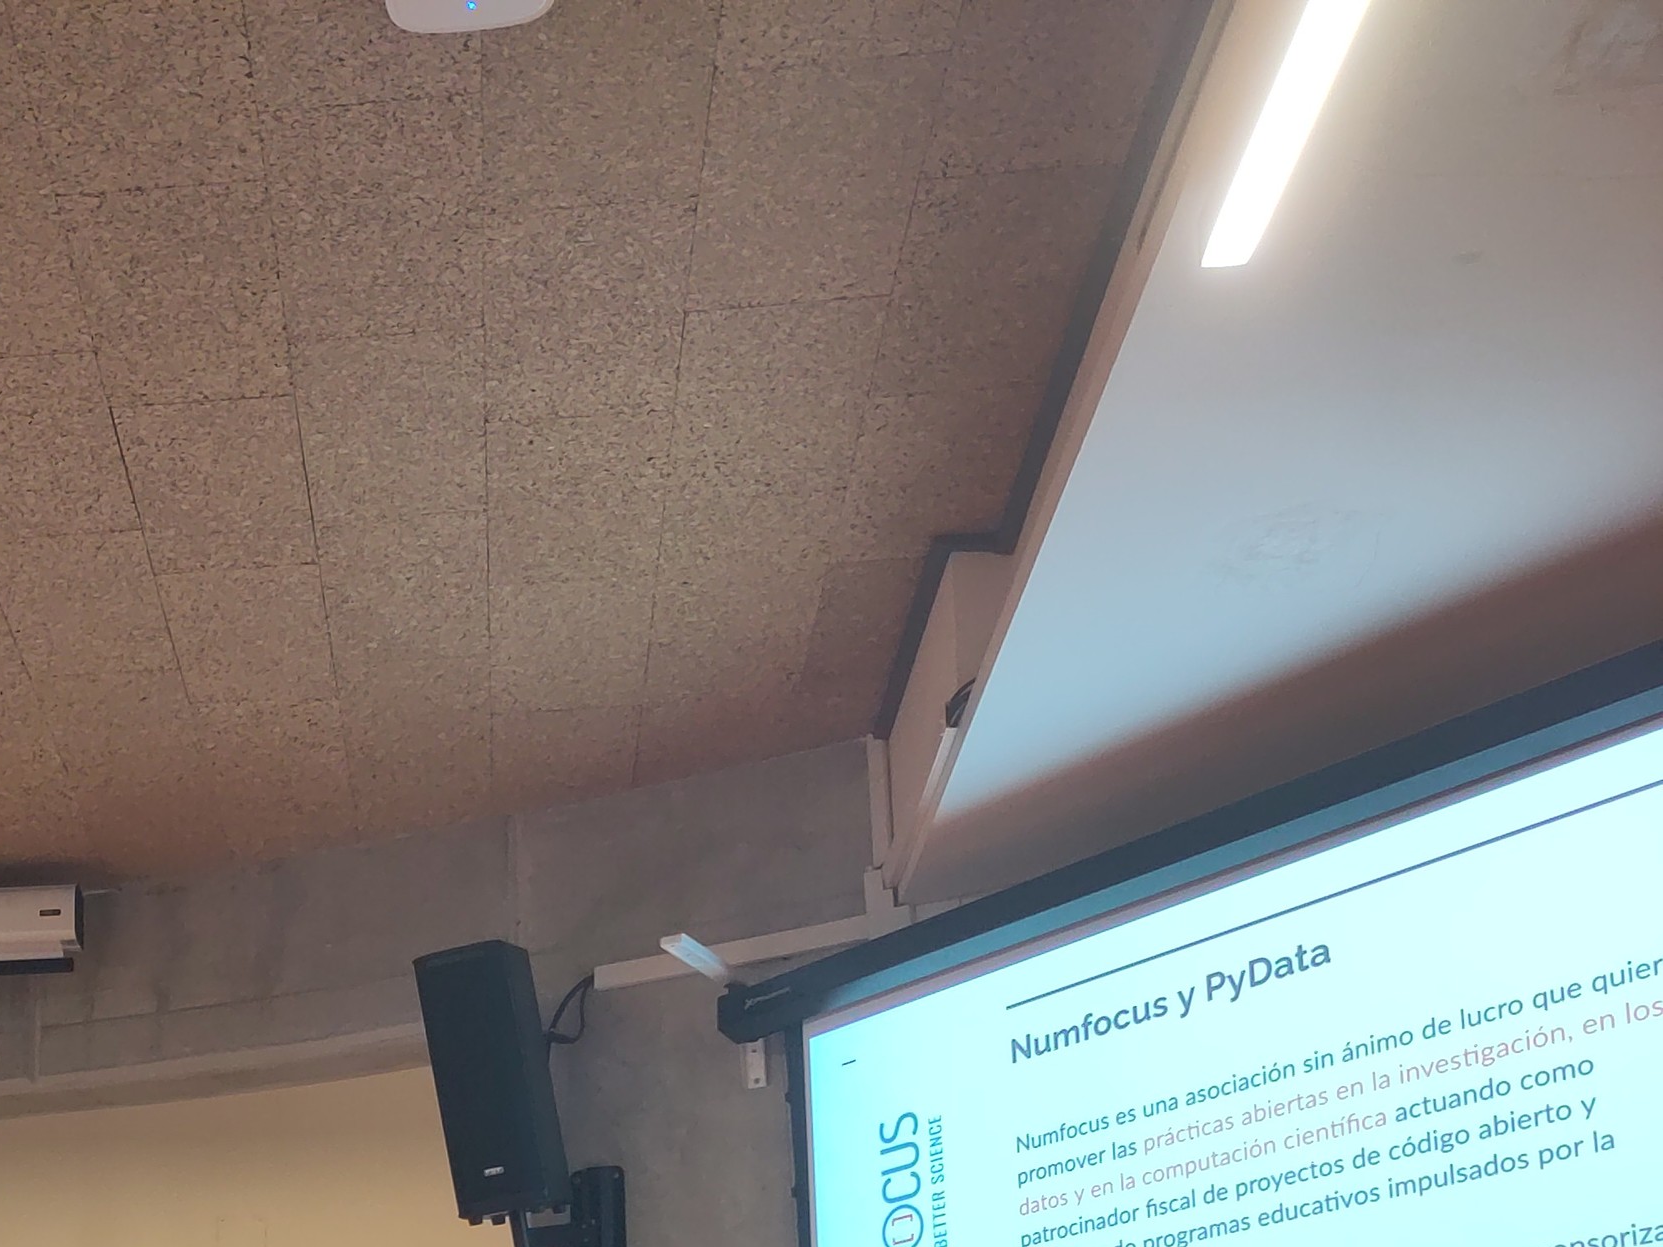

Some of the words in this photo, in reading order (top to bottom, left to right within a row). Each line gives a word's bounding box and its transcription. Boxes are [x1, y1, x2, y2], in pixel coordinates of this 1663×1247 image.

[1011, 997, 1168, 1064] Numfocus
[1177, 986, 1195, 1019] y
[1206, 944, 1331, 1003] PyData
[1016, 1116, 1110, 1153] Numfocus
[1116, 1108, 1136, 1125] es
[1143, 1097, 1178, 1118] una
[1186, 1062, 1295, 1106] asociación
[1303, 1050, 1334, 1073] sin
[1342, 1030, 1414, 1063] ánimo
[1422, 1017, 1452, 1040] de
[1460, 999, 1523, 1029] lucro
[1532, 982, 1582, 1011] que
[1018, 1150, 1106, 1189] promover
[1112, 1142, 1137, 1160] las
[1144, 1116, 1234, 1155] prácticas
[1242, 1091, 1328, 1125] abiertas
[1337, 1082, 1363, 1100] en
[1372, 1072, 1390, 1091] la
[1399, 1026, 1573, 1084] investigación,
[1583, 1014, 1615, 1034] en
[928, 1115, 945, 1185] SCIENCE
[1020, 1193, 1068, 1216] datos
[1074, 1188, 1084, 1206] y
[1091, 1182, 1113, 1198] en
[1120, 1173, 1135, 1191] la
[1142, 1139, 1275, 1185] computación
[1284, 1112, 1386, 1149] científica
[1395, 1077, 1511, 1122] actuando
[1520, 1059, 1594, 1090] como
[1146, 1188, 1196, 1218] fiscal
[1203, 1184, 1228, 1205] de
[1236, 1159, 1344, 1201] proyectos
[1352, 1147, 1381, 1169] de
[1389, 1129, 1470, 1160] código
[1479, 1104, 1572, 1140] abierto
[1580, 1097, 1596, 1120] y
[1258, 1187, 1380, 1227] educativos
[1388, 1153, 1529, 1198] impulsados
[1538, 1140, 1584, 1170] por
[1593, 1130, 1615, 1153] la
